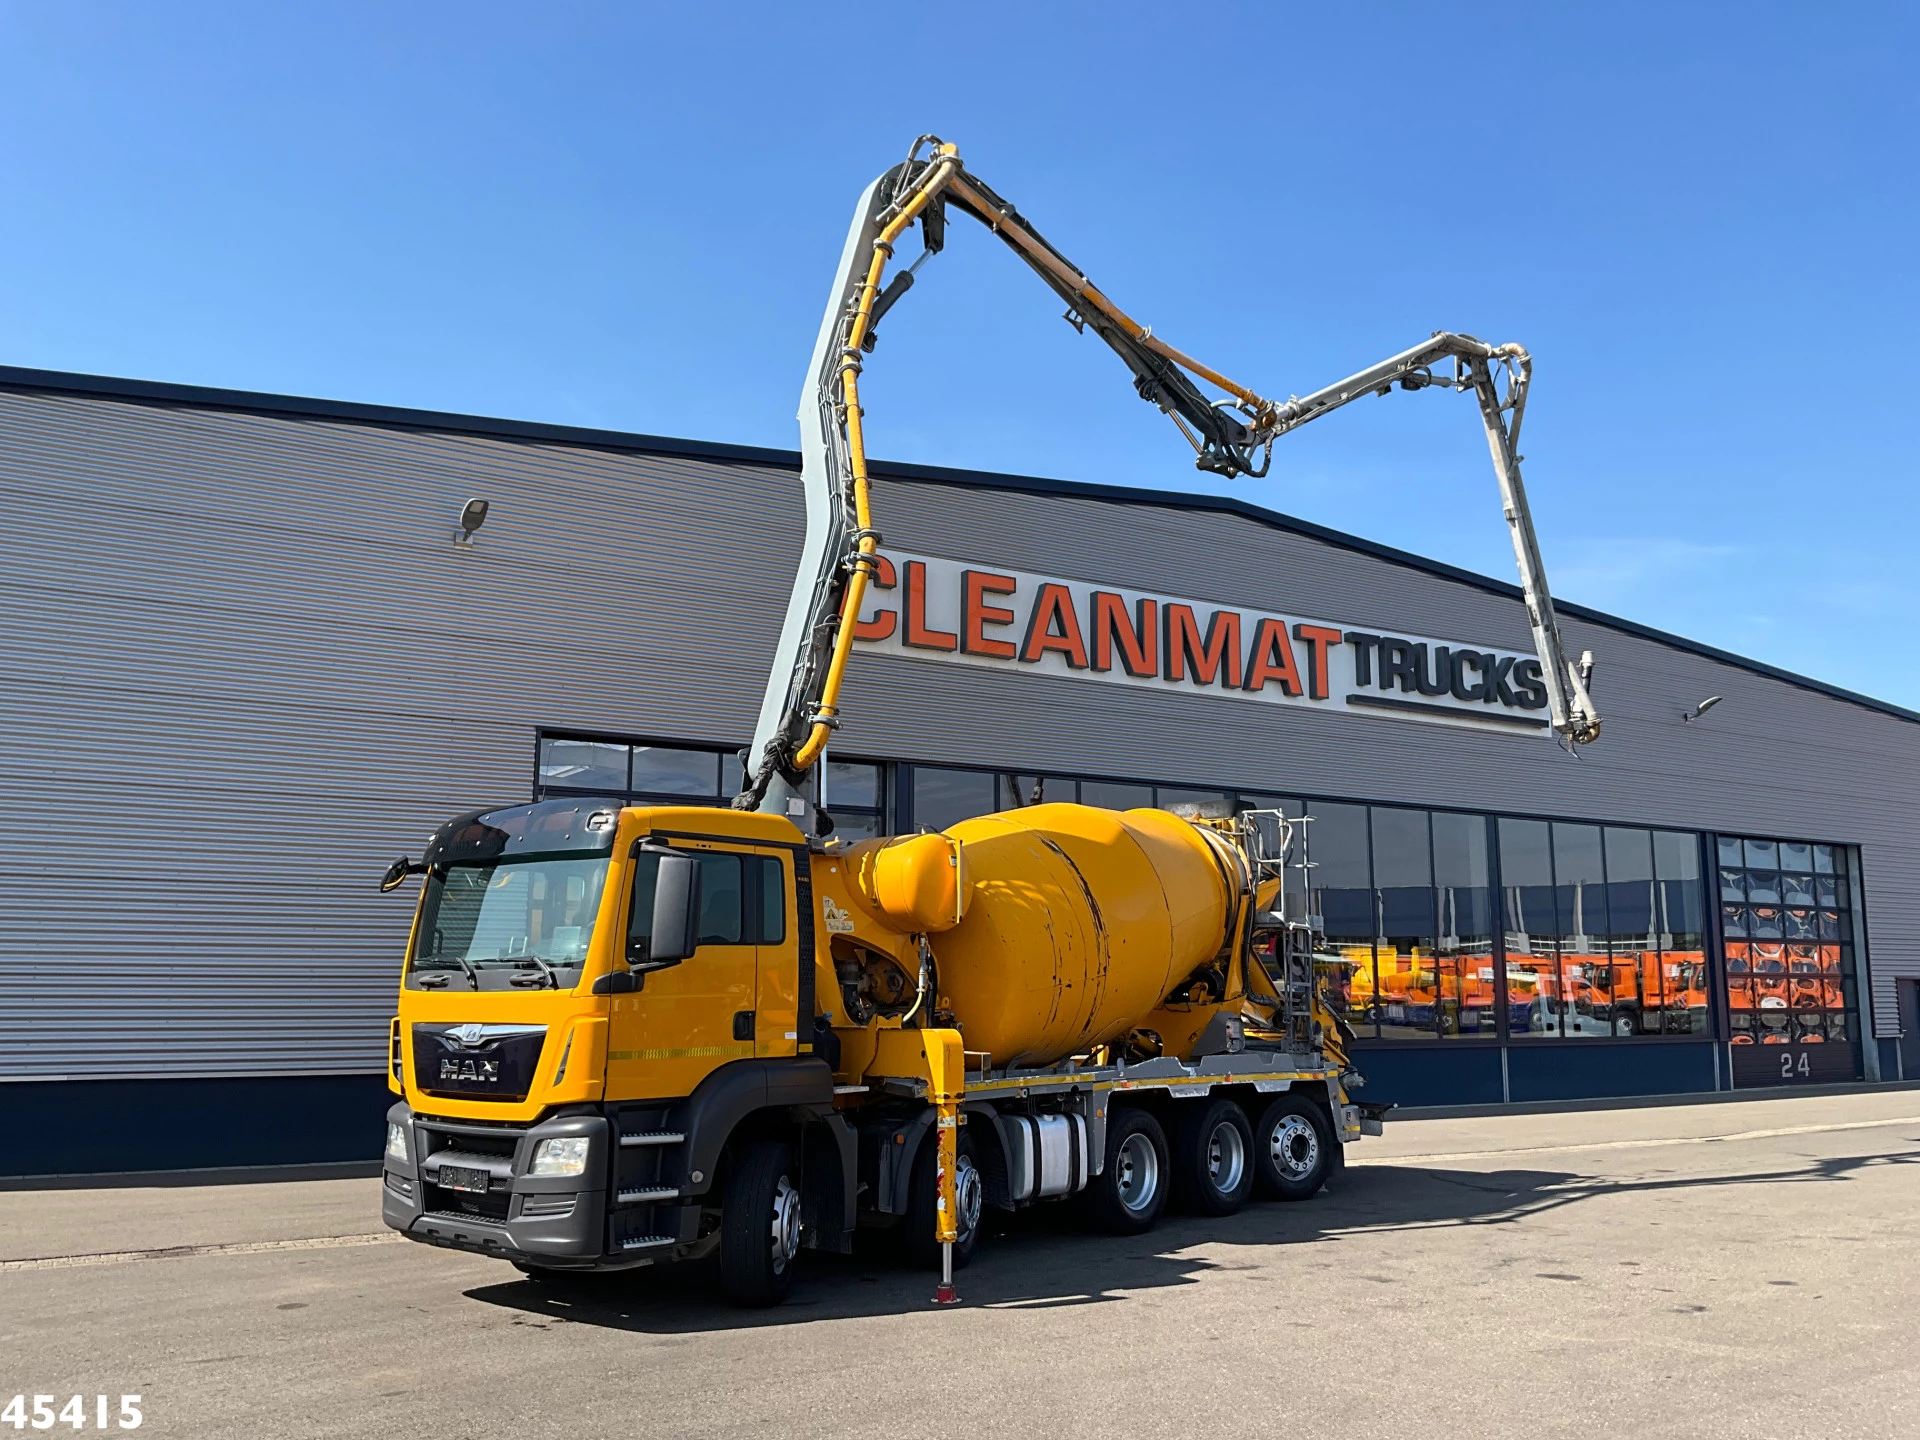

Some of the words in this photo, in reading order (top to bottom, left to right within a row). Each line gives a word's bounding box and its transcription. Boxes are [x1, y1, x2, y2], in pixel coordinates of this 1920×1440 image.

[838, 554, 1342, 700] CLEANMAT
[1344, 631, 1549, 710] TRUCKS
[440, 1058, 499, 1082] MAN
[1780, 1052, 1810, 1078] 24
